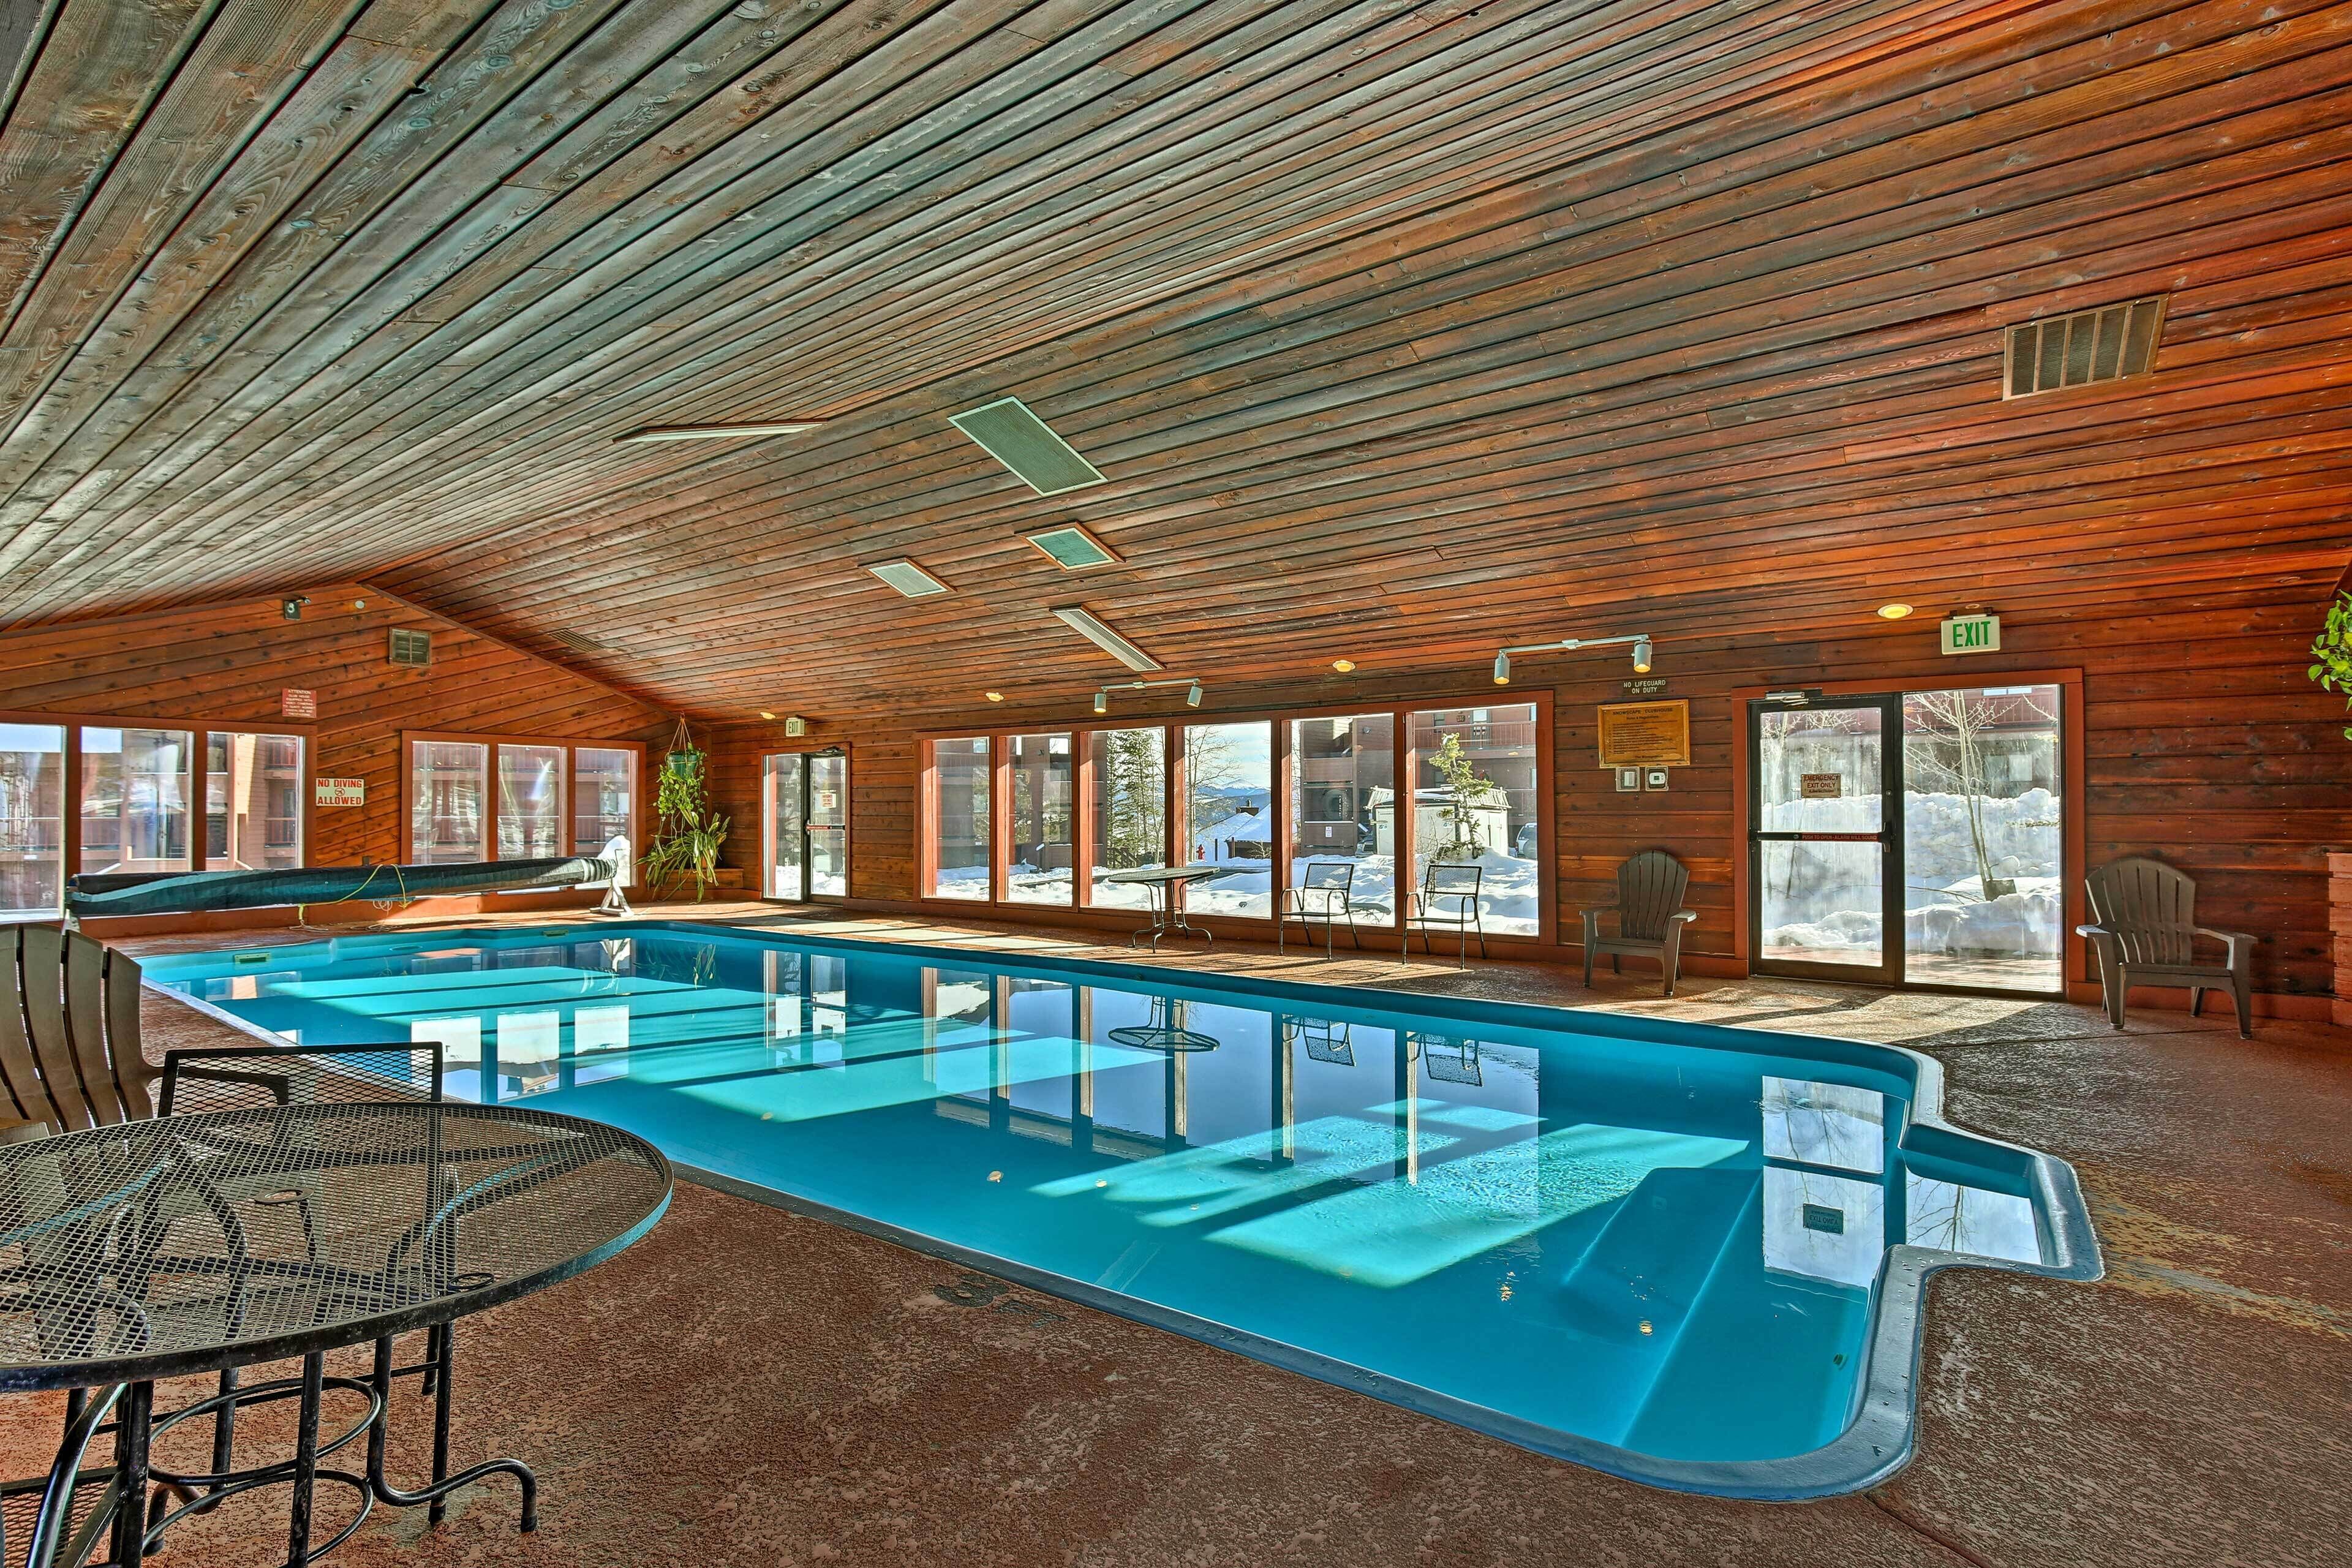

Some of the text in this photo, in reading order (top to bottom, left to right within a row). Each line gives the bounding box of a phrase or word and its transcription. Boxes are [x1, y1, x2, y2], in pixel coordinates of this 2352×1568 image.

[1953, 621, 1991, 647] EXIT
[789, 721, 799, 734] EXIT
[317, 778, 330, 788] NO
